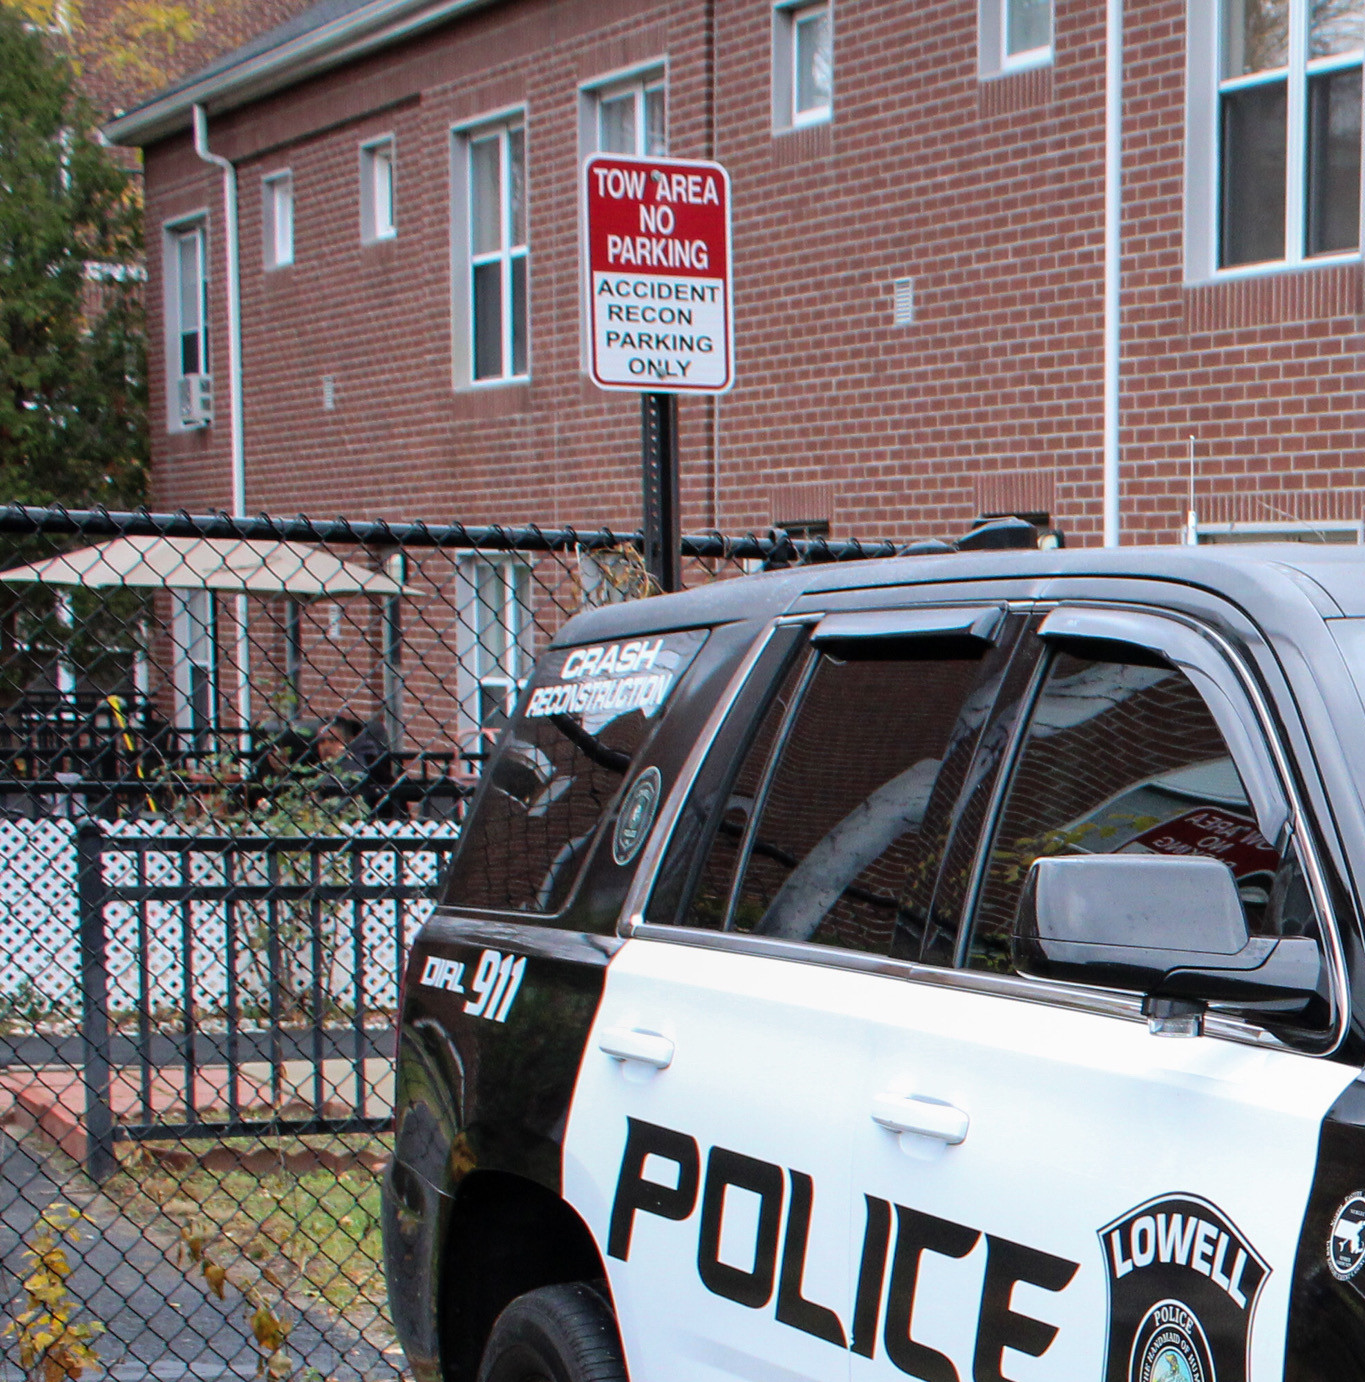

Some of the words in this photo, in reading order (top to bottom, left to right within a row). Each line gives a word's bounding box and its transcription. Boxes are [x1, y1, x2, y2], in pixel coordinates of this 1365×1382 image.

[594, 168, 645, 200] TOW
[656, 173, 719, 205] AREA
[639, 204, 674, 234] NO
[607, 234, 709, 270] PARKING
[598, 279, 719, 302] ACCIDENT
[608, 304, 692, 325] RECON
[606, 331, 713, 352] PARKING
[628, 358, 691, 377] ONLY
[560, 639, 664, 680] CRASH
[524, 674, 673, 718] RECONSTRUCTION
[420, 955, 465, 994] DIAL
[463, 949, 528, 1023] 911
[1111, 1212, 1248, 1311] LOWELL
[1154, 1306, 1194, 1335] POLICE
[1147, 1332, 1181, 1363] HANDMAID
[1181, 1340, 1190, 1353] OF
